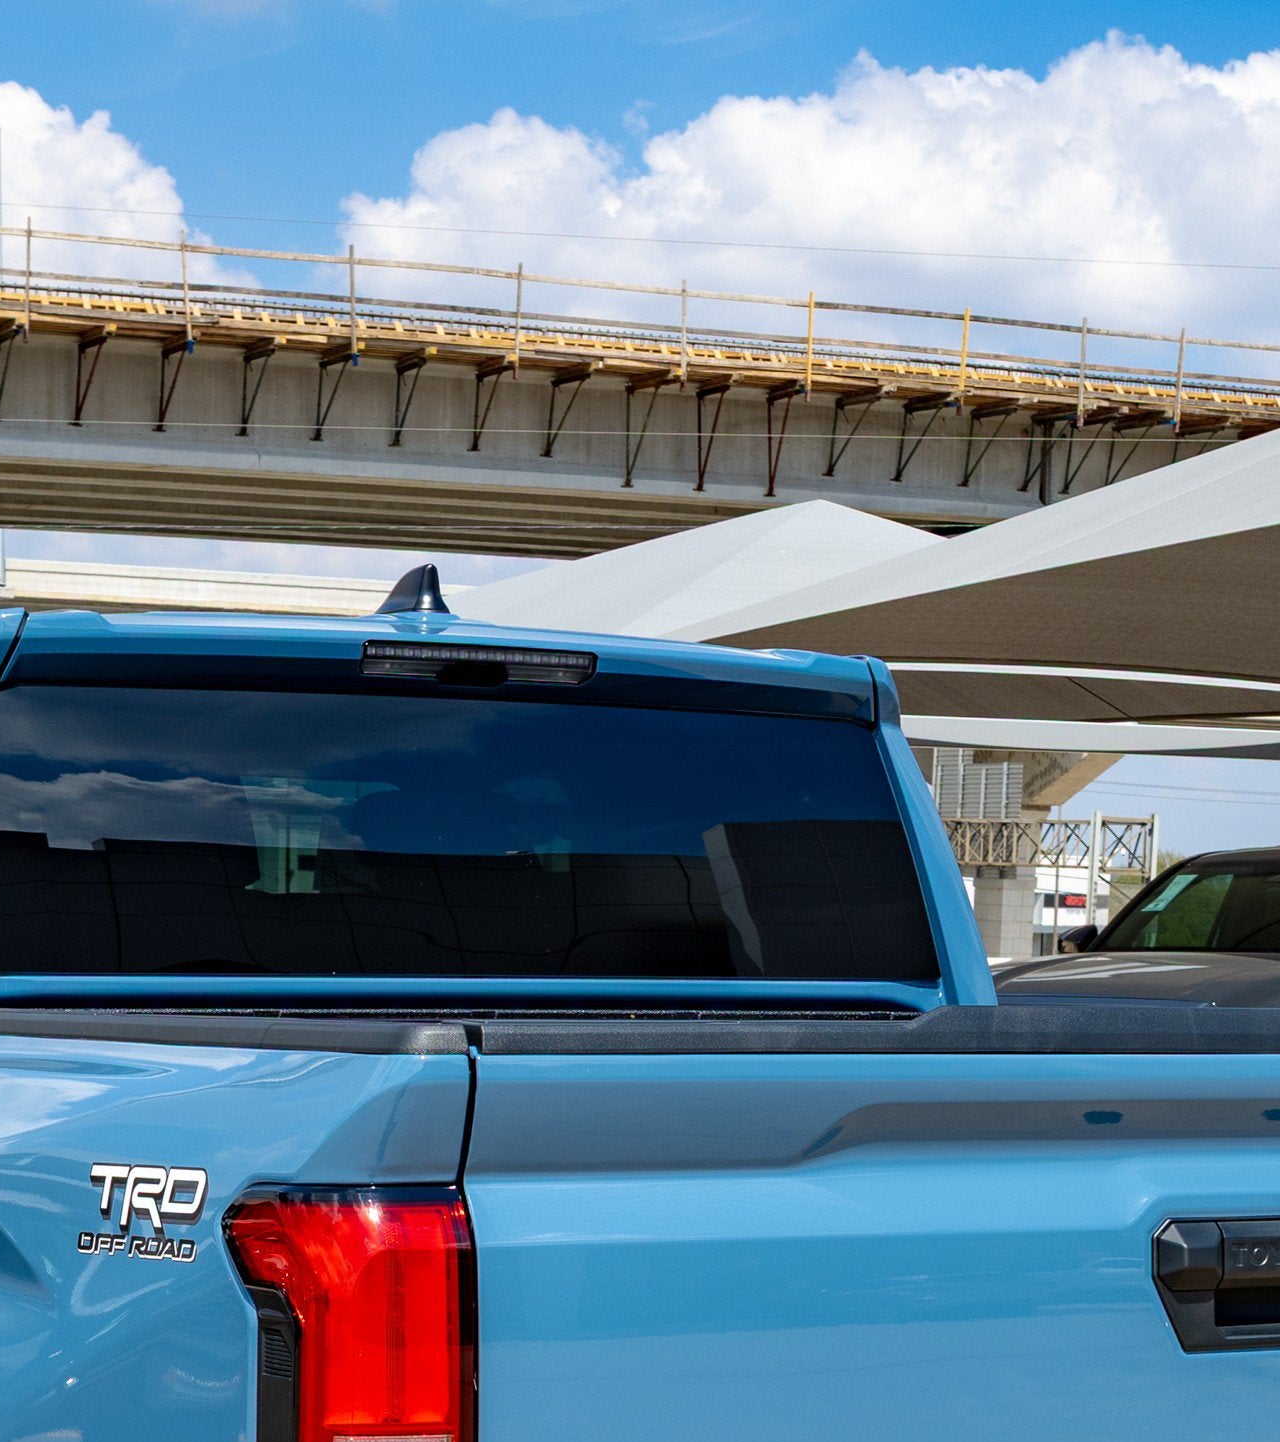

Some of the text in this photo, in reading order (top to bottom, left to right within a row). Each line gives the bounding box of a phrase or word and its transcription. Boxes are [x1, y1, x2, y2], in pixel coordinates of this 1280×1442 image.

[90, 1162, 209, 1232] TRD
[77, 1231, 197, 1264] OFF ROAD
